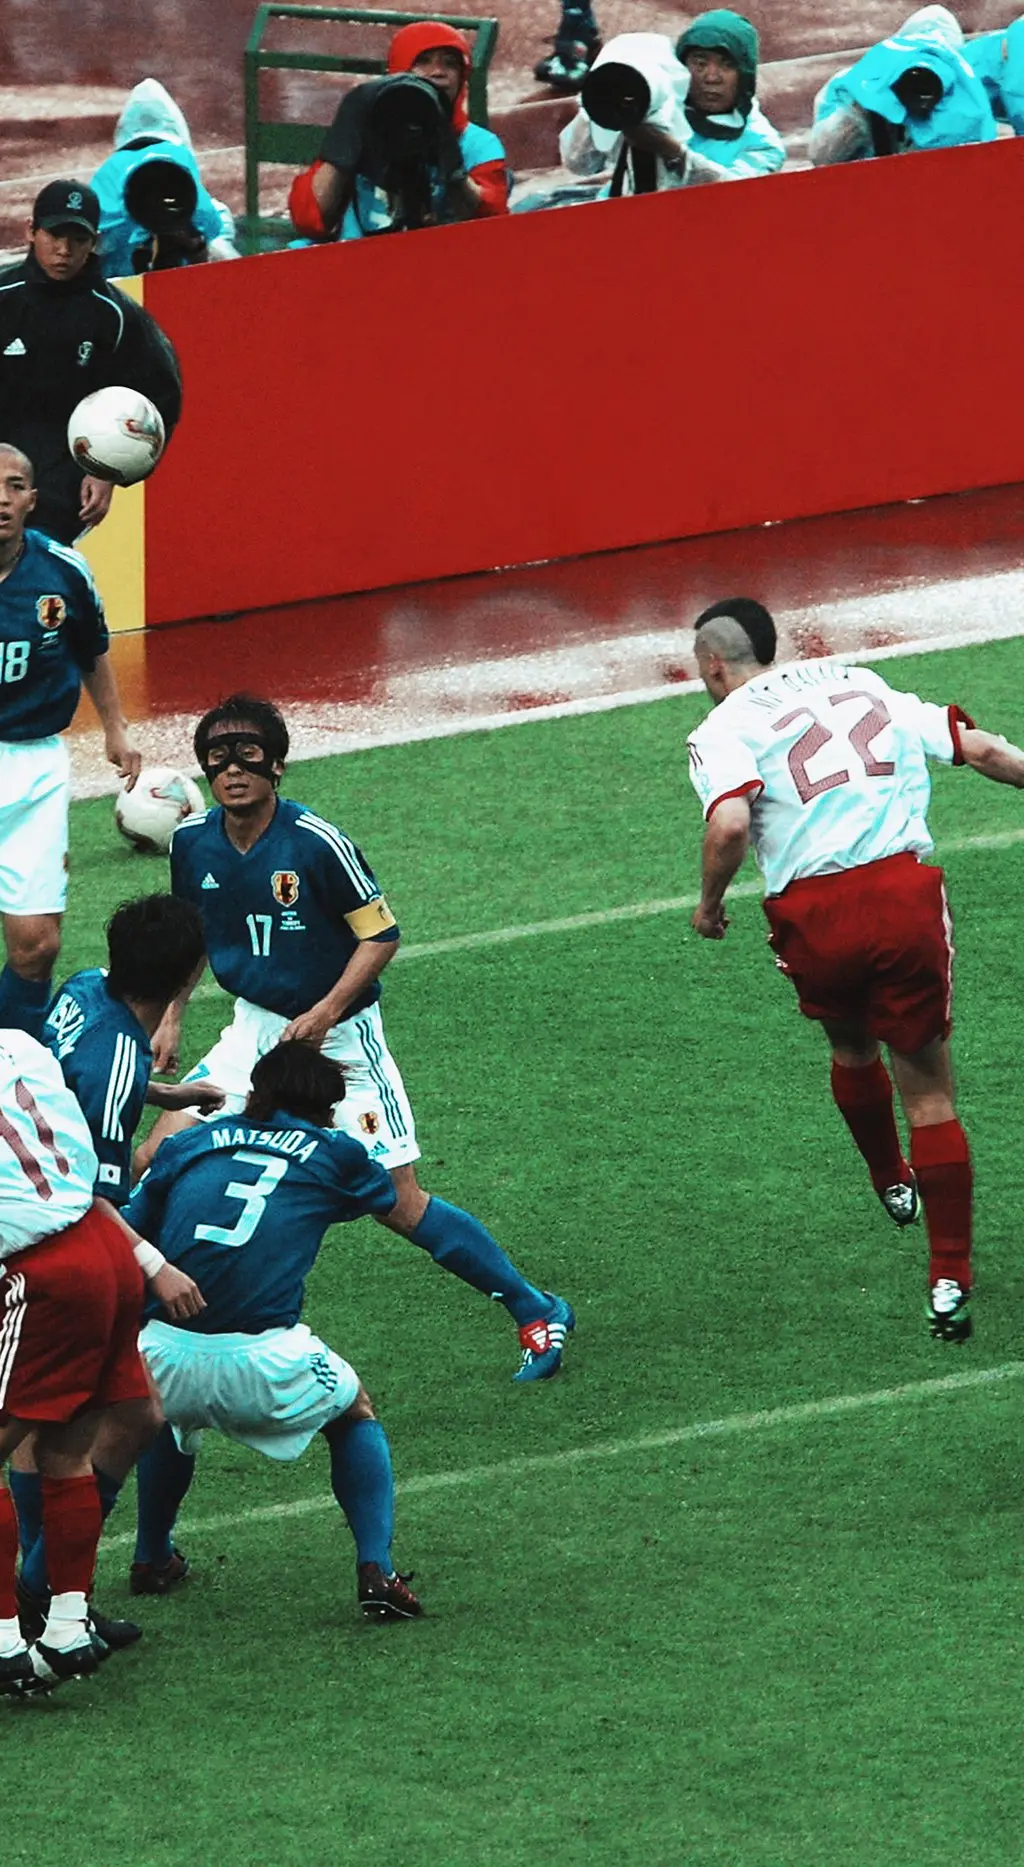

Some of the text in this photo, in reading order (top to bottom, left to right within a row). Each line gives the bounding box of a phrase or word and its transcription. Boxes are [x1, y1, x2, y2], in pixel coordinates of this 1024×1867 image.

[771, 690, 895, 804] 22
[245, 914, 273, 957] 17
[211, 1127, 320, 1164] MATSUDA
[193, 1149, 289, 1247] 3
